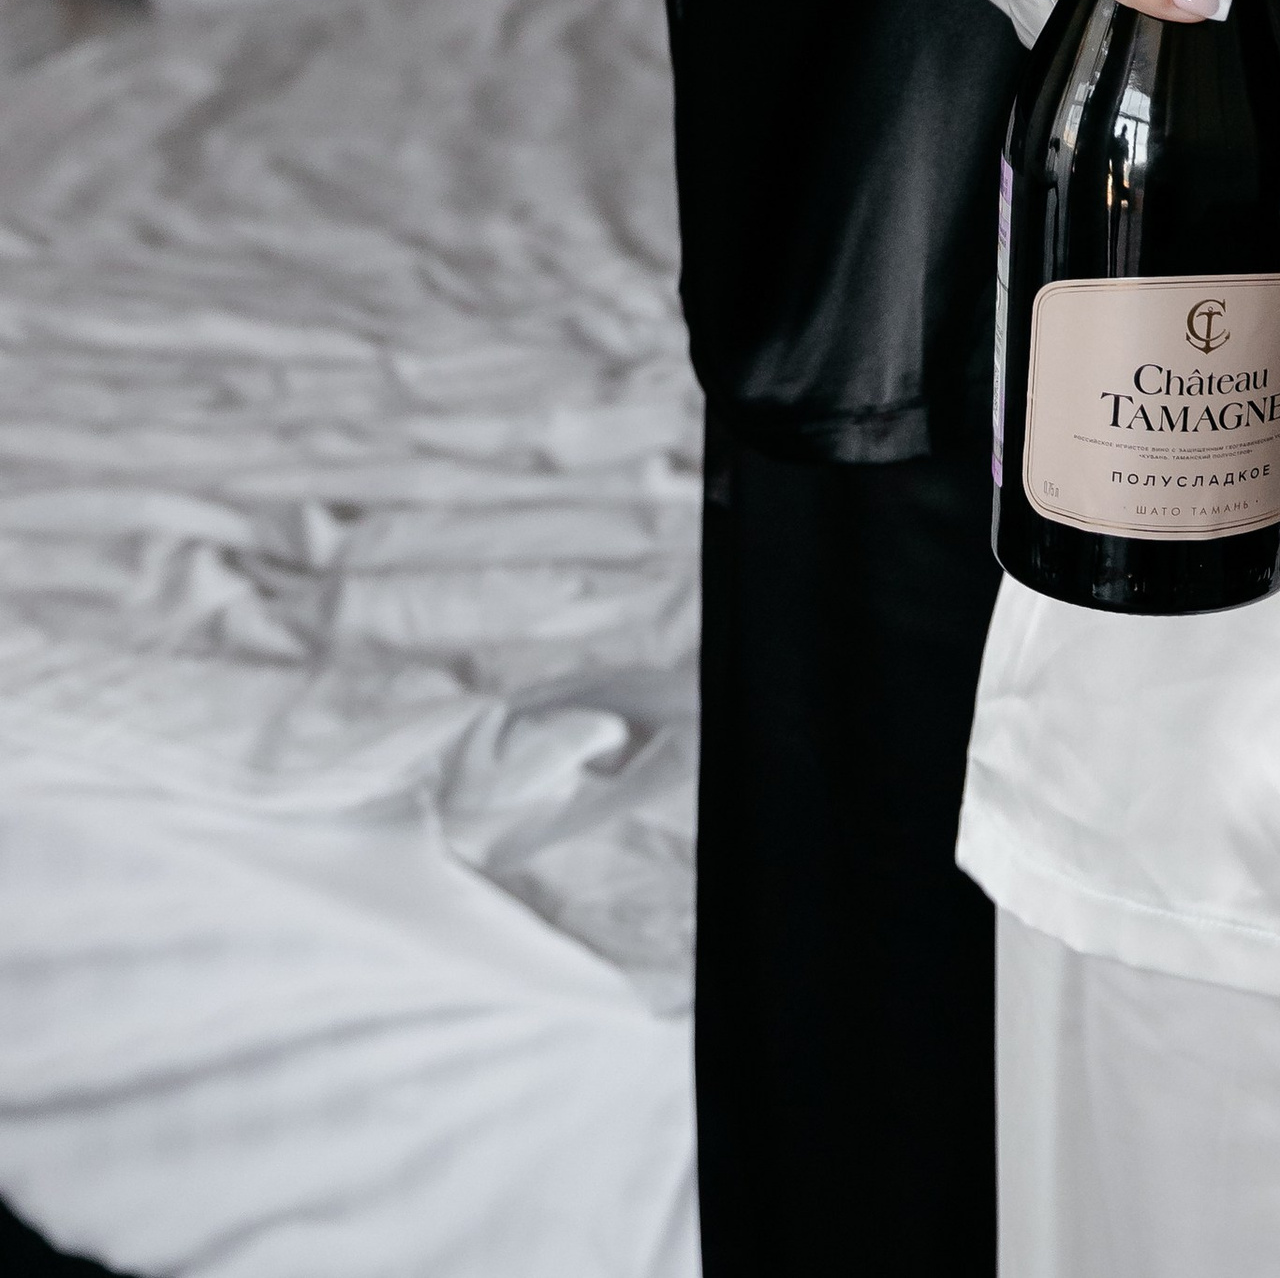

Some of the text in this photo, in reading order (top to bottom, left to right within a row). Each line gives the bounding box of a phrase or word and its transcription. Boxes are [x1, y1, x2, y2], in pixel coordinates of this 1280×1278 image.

[1133, 364, 1268, 396] Château
[1111, 464, 1271, 488] ПОЛУСЛАДКОЕ
[1136, 501, 1249, 517] ШАТО ТАМАНЬ
